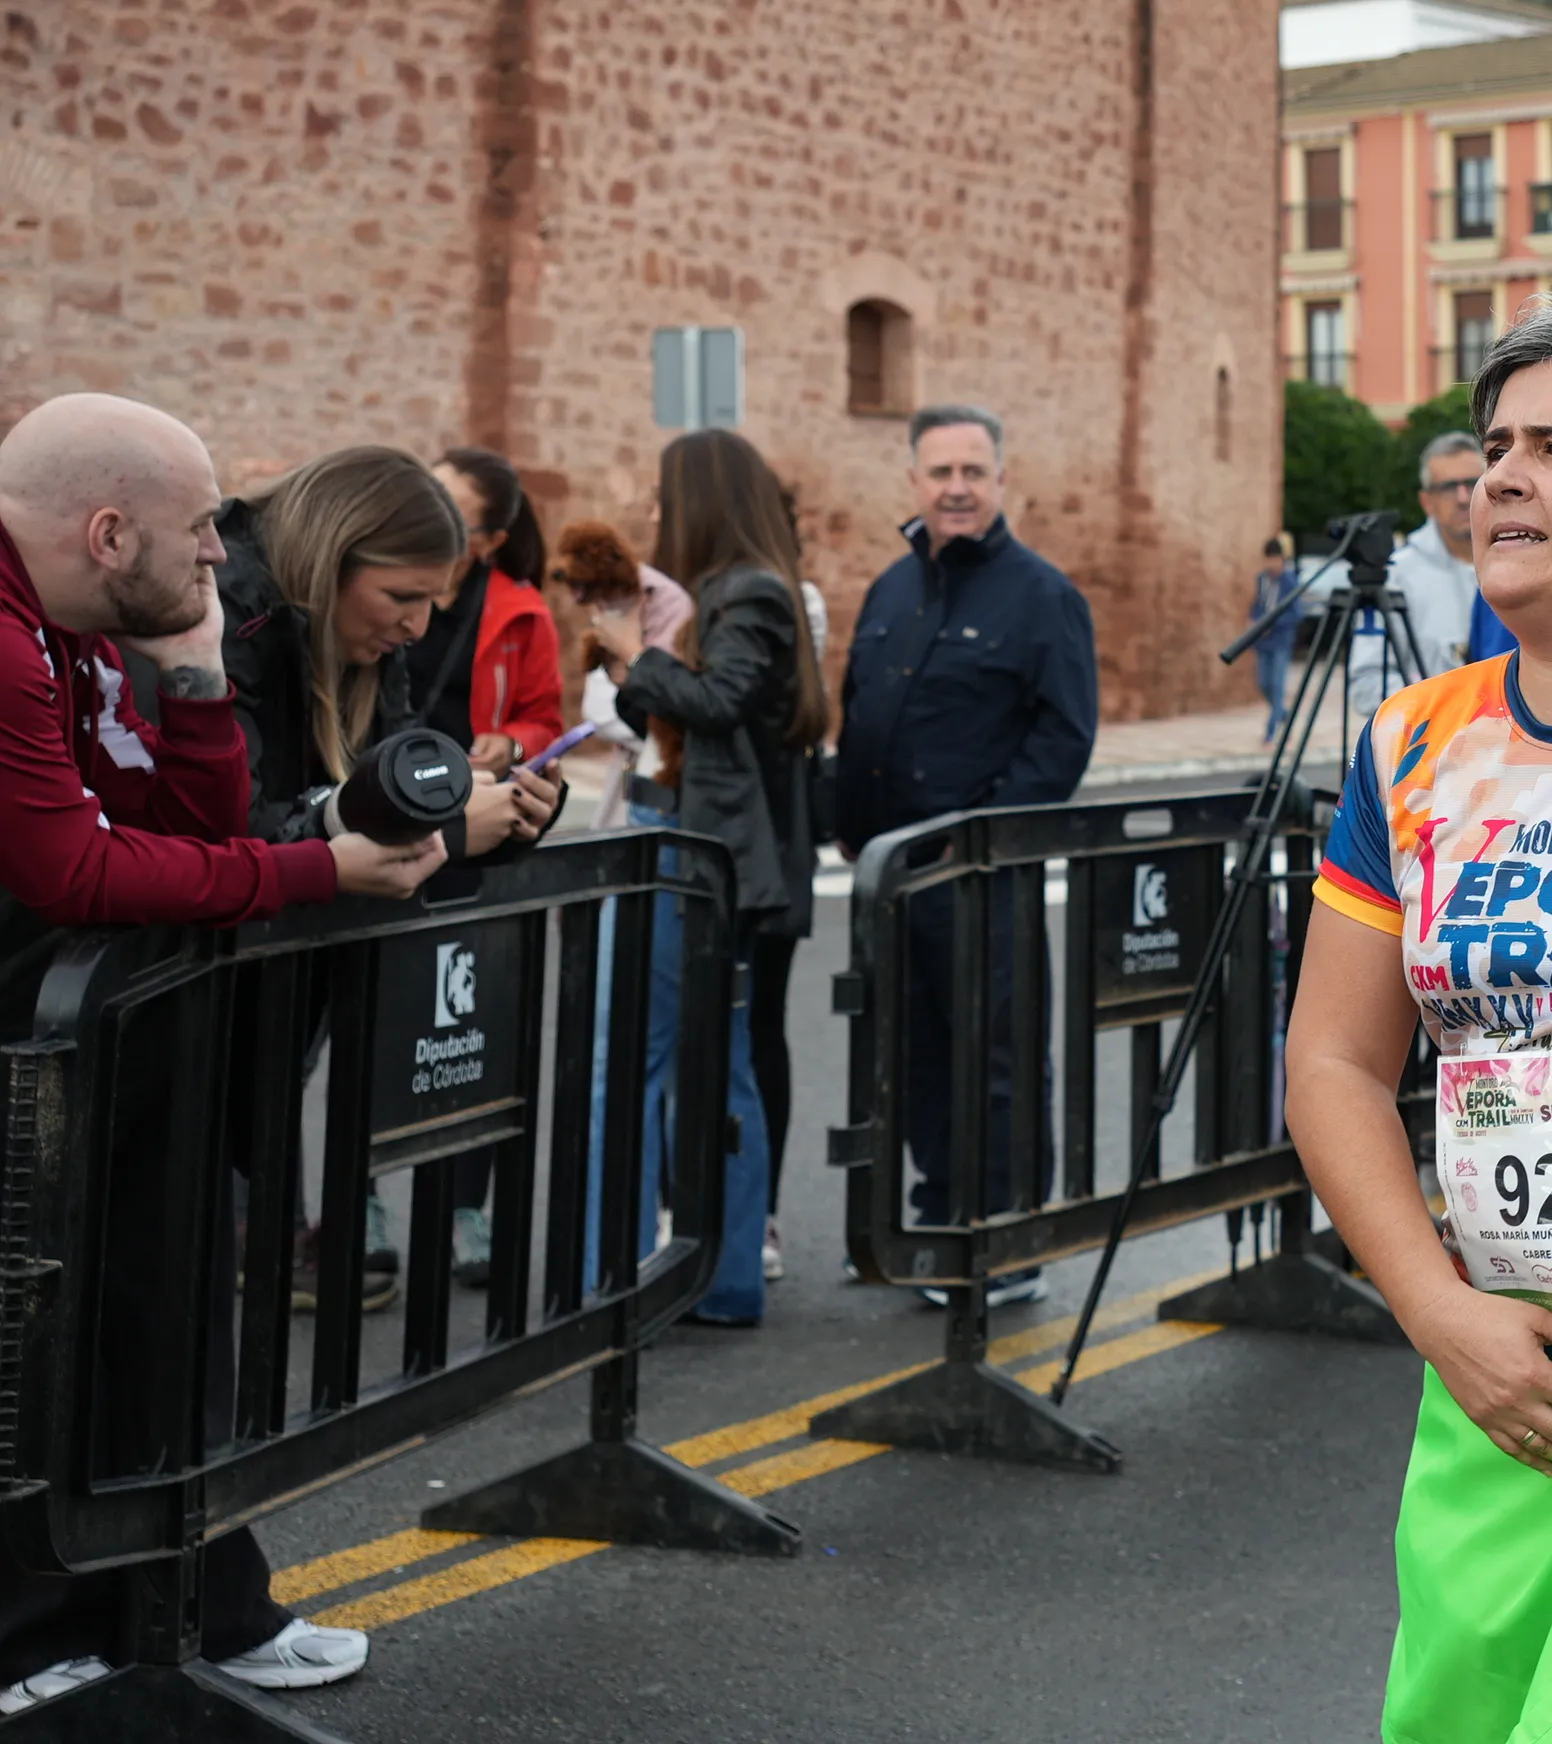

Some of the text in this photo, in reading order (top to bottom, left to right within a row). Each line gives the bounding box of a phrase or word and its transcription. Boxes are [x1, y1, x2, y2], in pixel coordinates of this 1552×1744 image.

[414, 765, 449, 781] Canon
[415, 1027, 485, 1067] Diputación
[412, 1058, 483, 1094] de Córdoba
[1466, 1089, 1516, 1110] EPORA
[1468, 1109, 1510, 1128] TRAIL
[1480, 1231, 1501, 1240] ROSA
[1502, 1229, 1530, 1240] MARÍA
